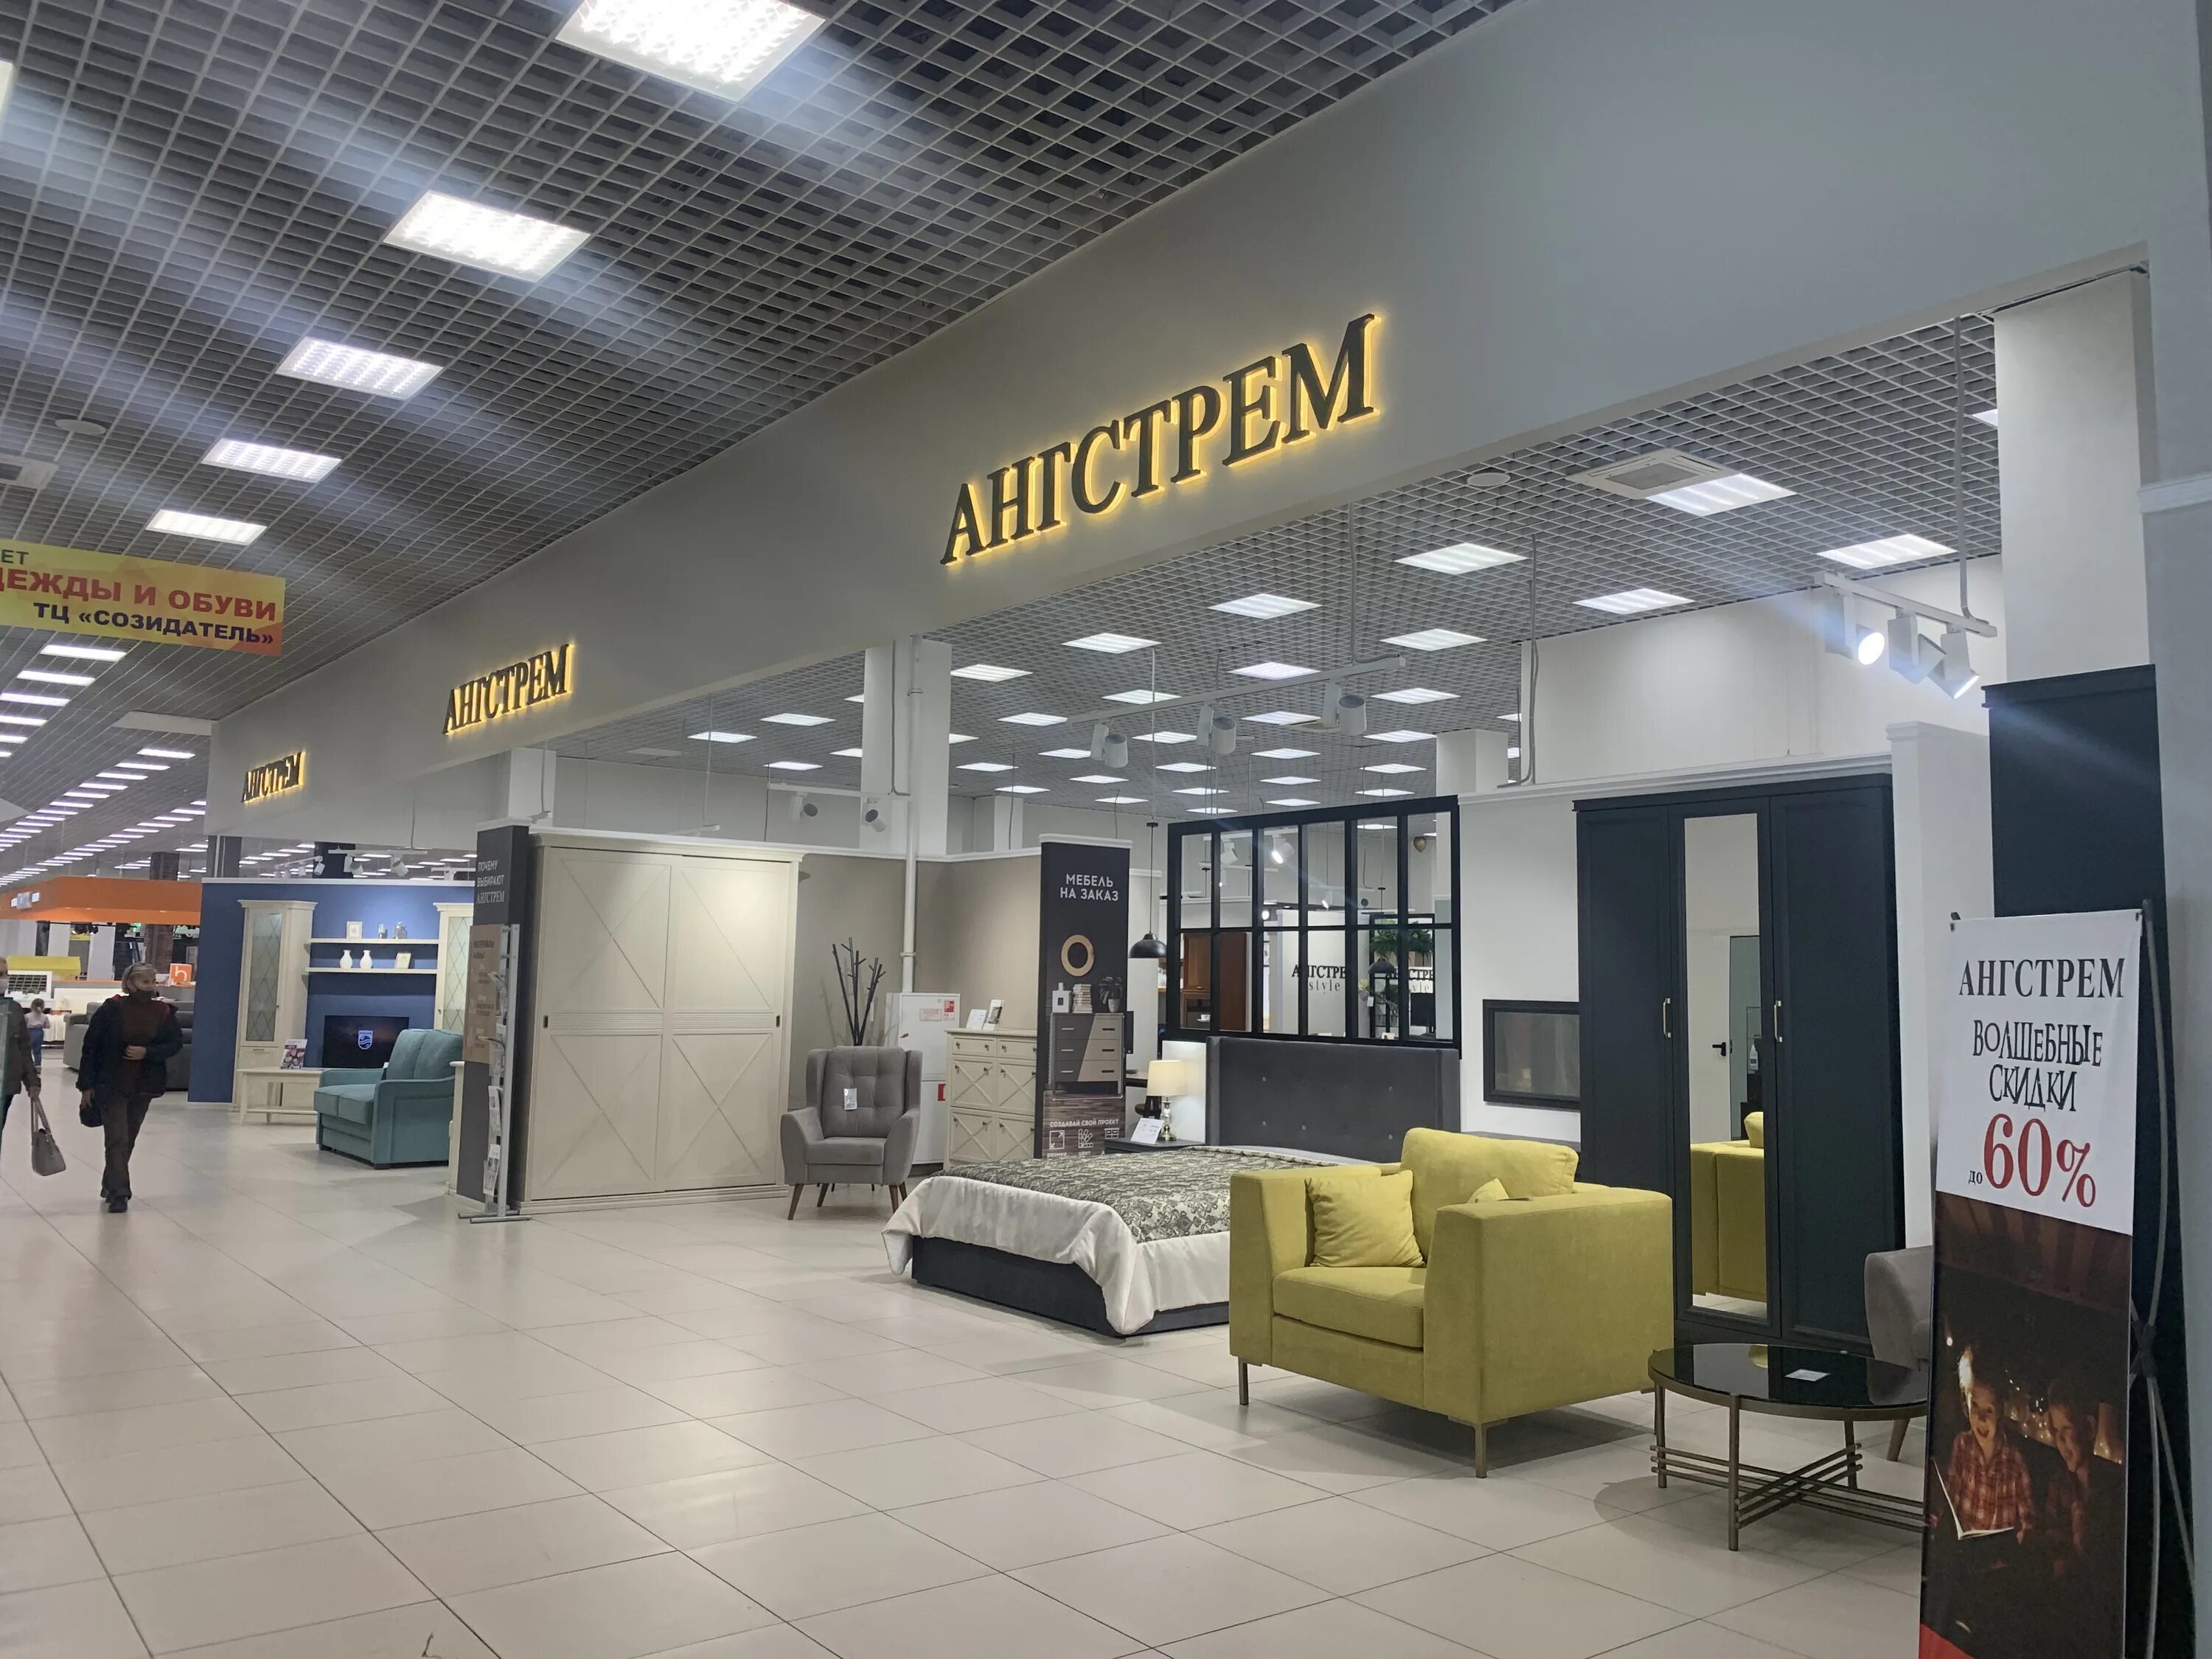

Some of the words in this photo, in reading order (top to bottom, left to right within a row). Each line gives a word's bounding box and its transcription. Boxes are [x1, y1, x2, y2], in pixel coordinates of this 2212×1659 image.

[940, 313, 1379, 565] АНГСТРЕМ
[0, 567, 121, 602] ЕЖДЫ
[133, 584, 156, 605] И
[168, 590, 276, 621] ОБУВИ
[33, 602, 69, 624] ТЦ
[79, 610, 274, 644] «СОЗИДАТЕЛЬ»
[442, 644, 571, 734] АНГСТРЕМ
[1060, 886, 1077, 899] НА
[1080, 888, 1119, 902] ЗАКАЗ
[1065, 873, 1113, 888] МЕБЕЛЬ
[1309, 979, 1340, 994] style
[1958, 958, 2125, 998] АНГСТРЕМ
[1972, 1020, 2103, 1068] ВОЛШЕБНЫЕ
[1989, 1064, 2077, 1112] СКИДКИ
[1081, 1118, 1096, 1127] СВОЙ
[1097, 1118, 1119, 1126] ПРОЕКТ
[1983, 1113, 2096, 1208] 60%
